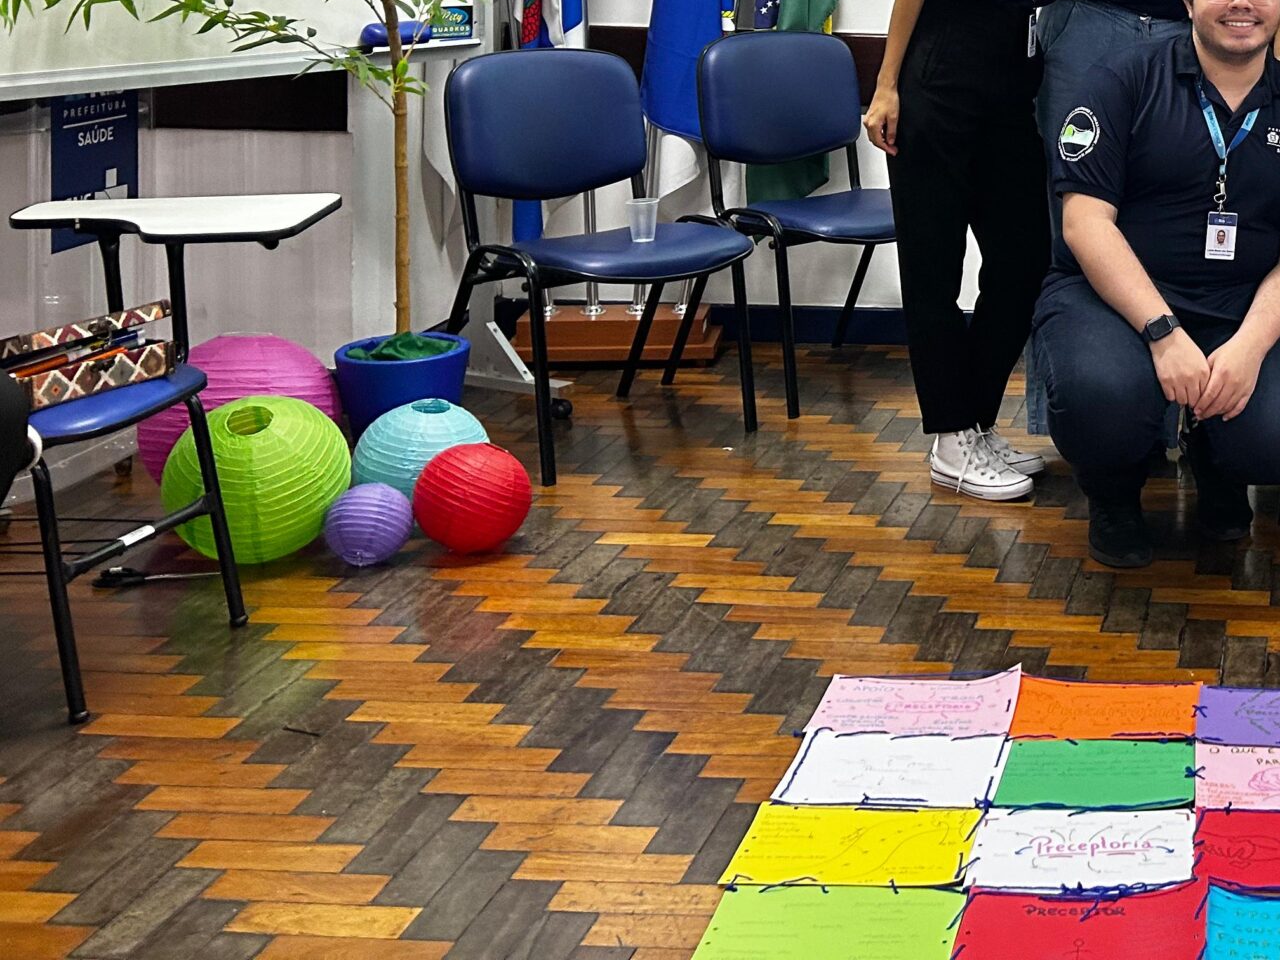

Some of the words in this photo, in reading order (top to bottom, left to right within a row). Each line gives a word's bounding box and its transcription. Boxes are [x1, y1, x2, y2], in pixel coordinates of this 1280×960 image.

[63, 99, 127, 119] PREFEITURA
[77, 125, 114, 147] SAÚDE
[1030, 836, 1153, 856] Preceptoria
